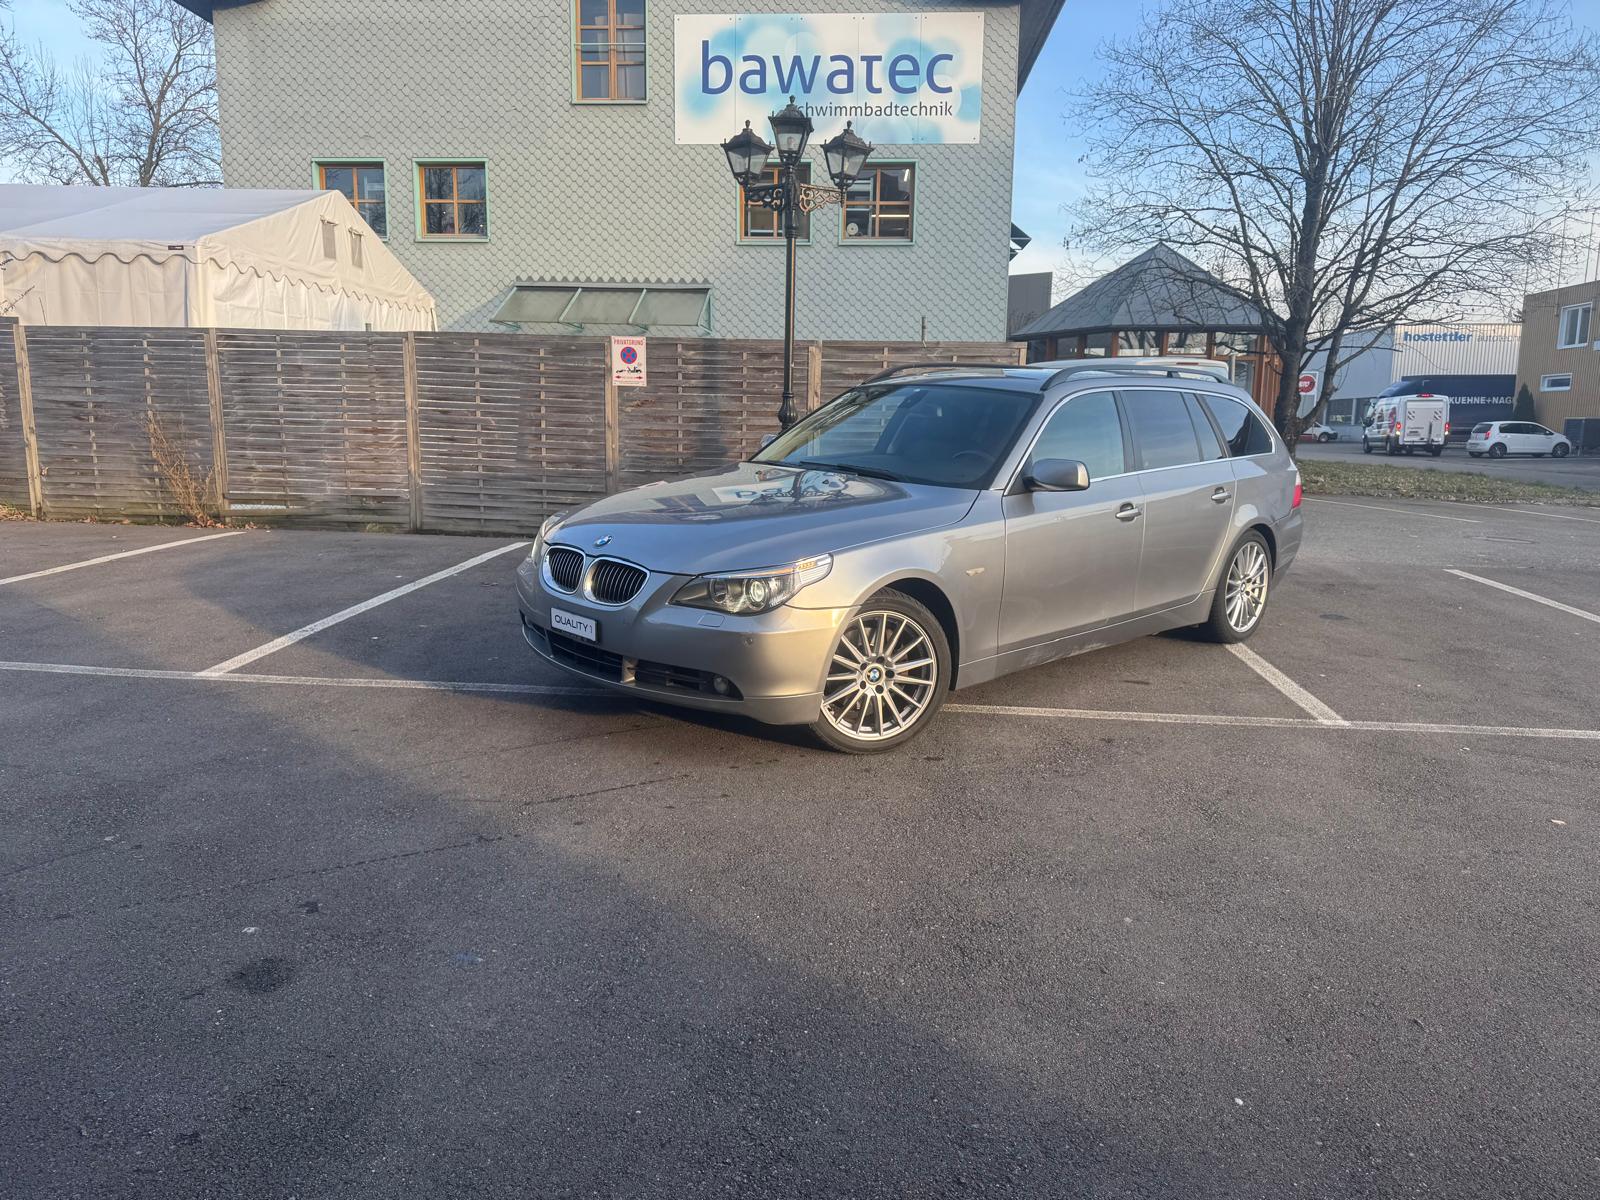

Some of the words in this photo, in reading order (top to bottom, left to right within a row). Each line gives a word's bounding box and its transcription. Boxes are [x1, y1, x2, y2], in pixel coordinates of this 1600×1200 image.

[701, 39, 954, 95] bawatec
[797, 101, 953, 118] chwimmbadtechnik
[1403, 331, 1473, 343] hostettler
[1448, 396, 1512, 405] KUEHNE+NAG
[554, 615, 588, 632] QUALITY
